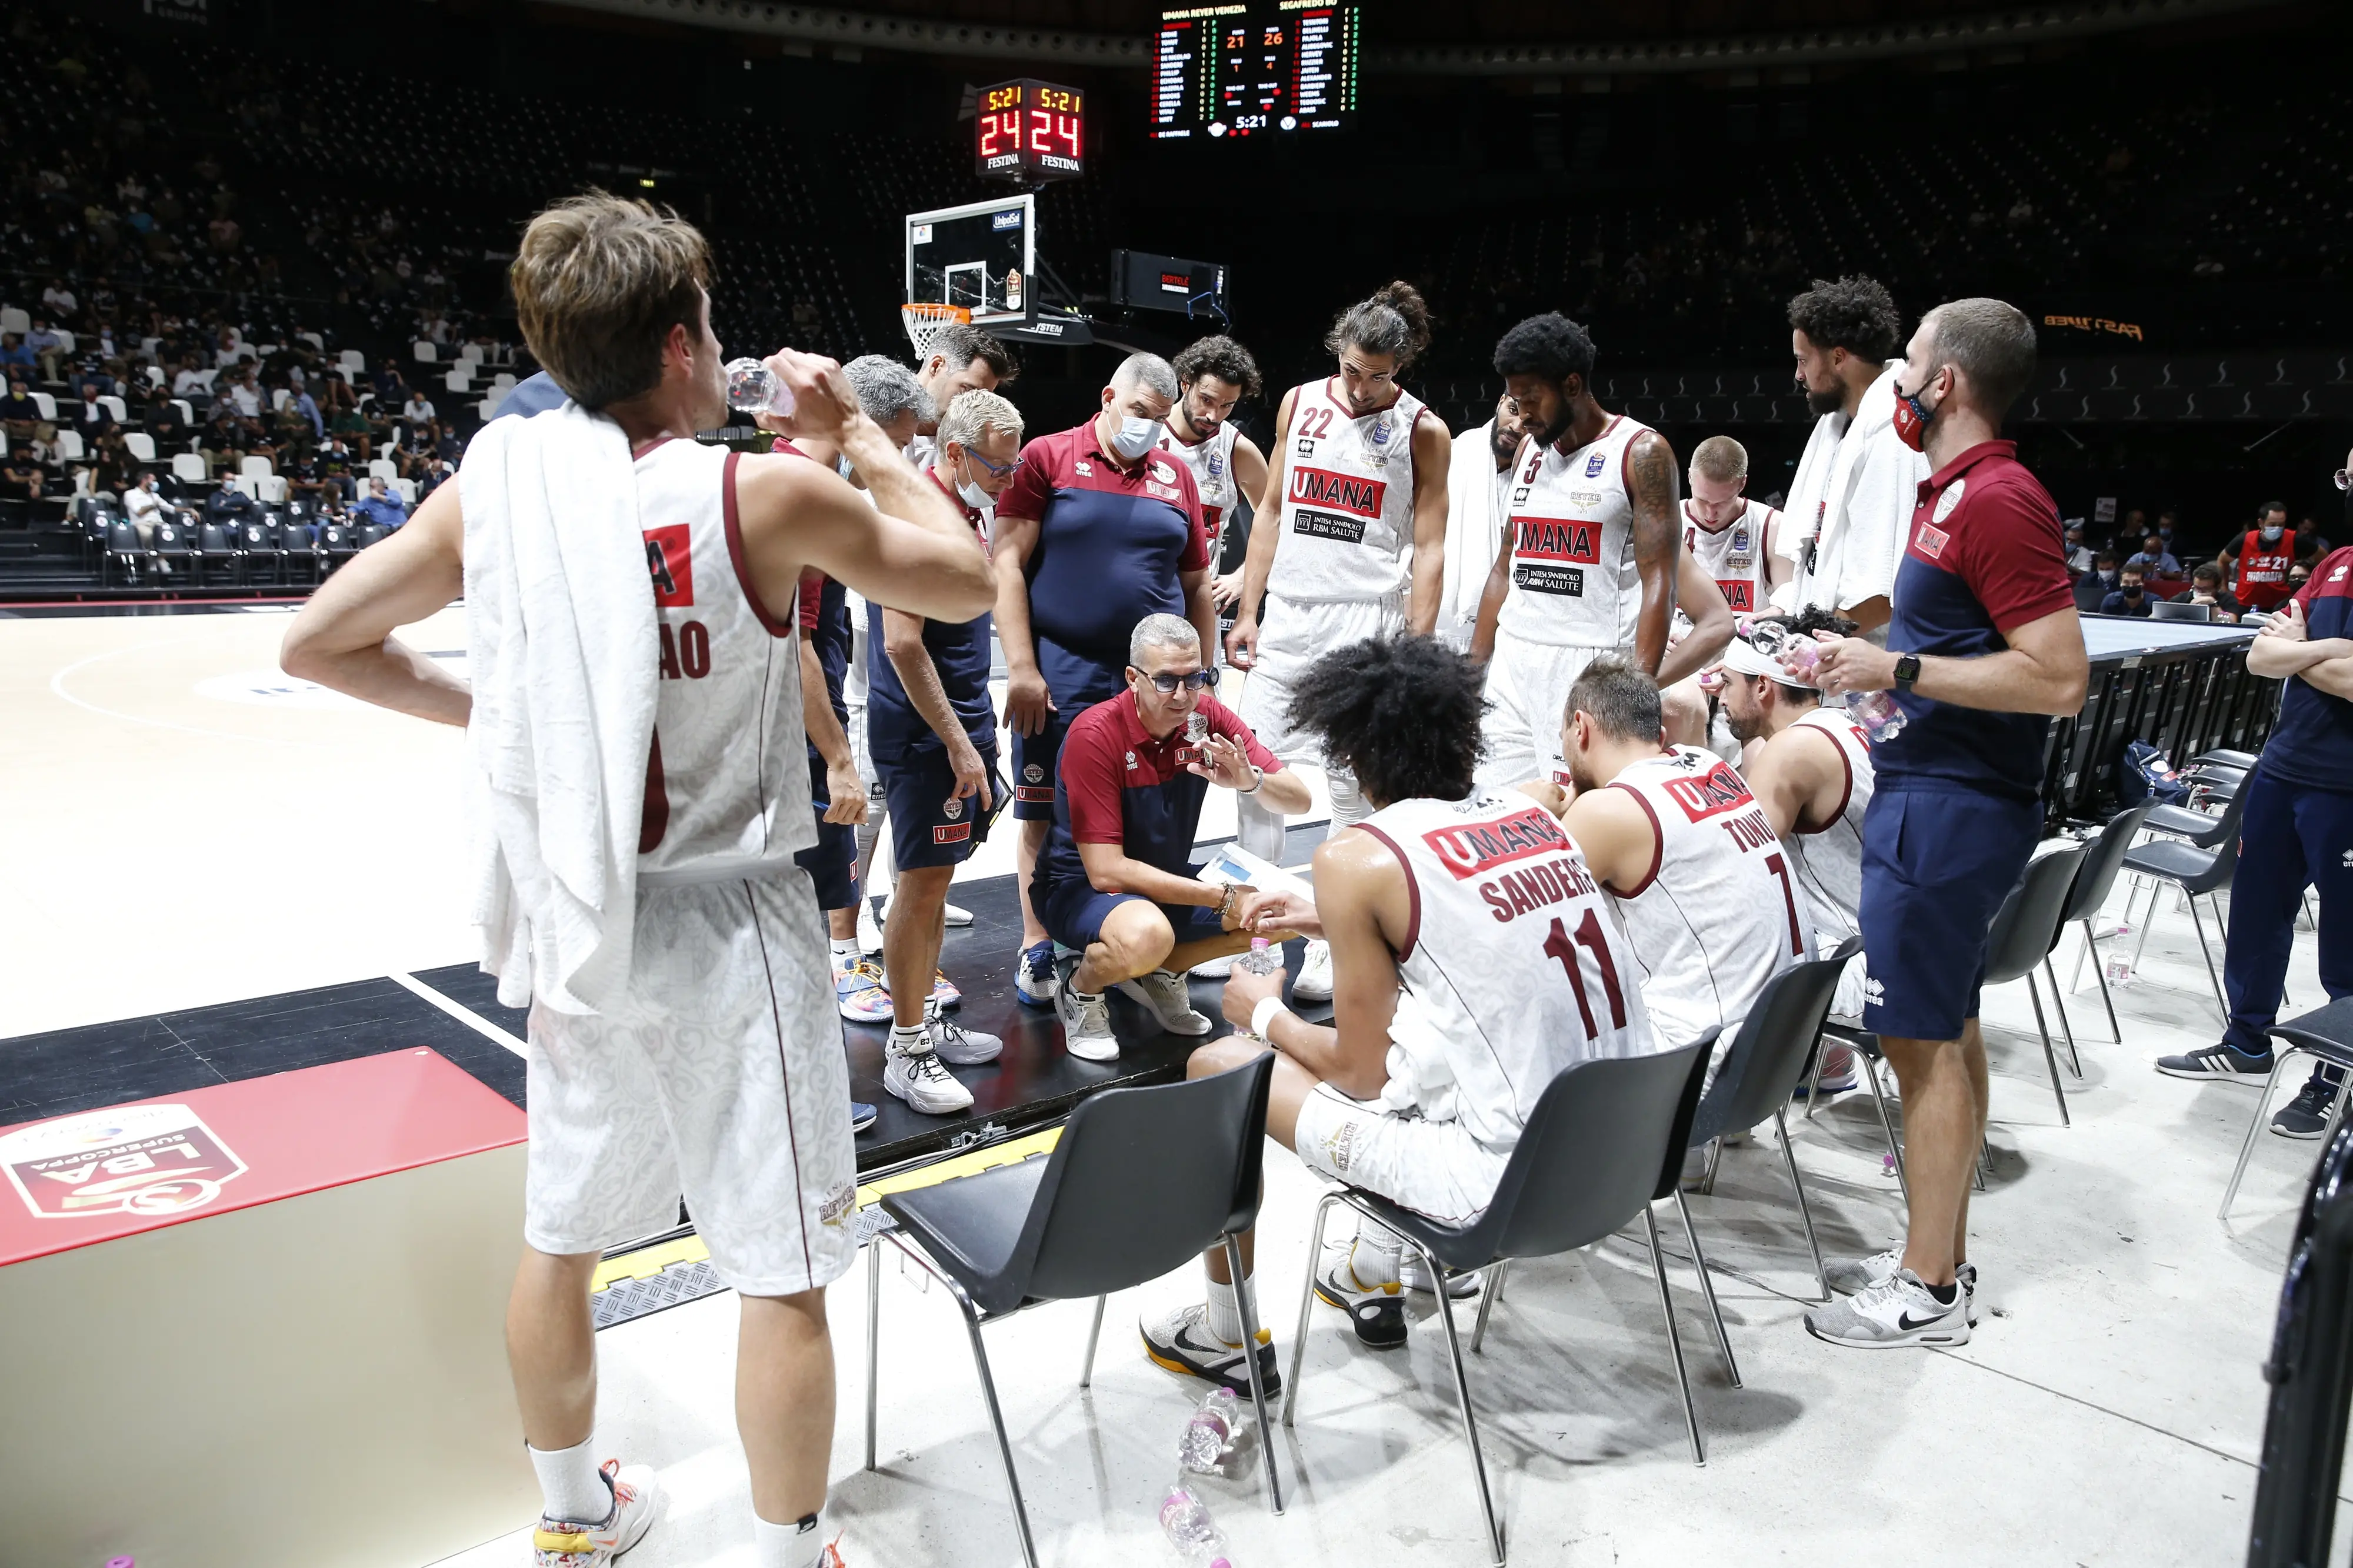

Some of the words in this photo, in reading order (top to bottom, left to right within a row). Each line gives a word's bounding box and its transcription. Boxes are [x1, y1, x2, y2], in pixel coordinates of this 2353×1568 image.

[1162, 9, 1190, 20] UMANA
[1191, 7, 1214, 18] REYER
[1215, 4, 1247, 15] VENEZIA
[1279, 0, 1324, 10] SEGAFREDO
[1227, 35, 1244, 49] 21
[1264, 32, 1283, 46] 26
[1267, 62, 1273, 70] 4
[989, 86, 1021, 111] 5:21
[1041, 88, 1080, 112] 5:21
[1236, 115, 1266, 129] 5:21
[982, 110, 1019, 156] 24
[1032, 111, 1078, 156] 24
[988, 154, 1019, 169] FESTINA
[1041, 155, 1080, 171] FESTINA
[994, 212, 1020, 227] UnipolSai
[1008, 284, 1019, 292] LBA
[1298, 407, 1334, 439] 22
[1360, 453, 1388, 465] REYER
[1075, 469, 1092, 478] errea
[1524, 452, 1542, 484] 5
[1294, 471, 1375, 513] UMANA
[1570, 492, 1601, 502] REYER
[1313, 523, 1329, 535] RBM
[1331, 526, 1359, 539] SALUTE
[1314, 516, 1331, 526] INTESA
[1332, 519, 1361, 531] SANPAOLO
[1512, 522, 1592, 558] UMANA
[2272, 556, 2288, 569] 21
[1547, 571, 1579, 581] SANPAOLO
[1527, 578, 1544, 588] RBM
[1545, 579, 1579, 591] SALUTE
[1019, 788, 1051, 799] UMANA
[937, 826, 967, 840] UMANA
[1436, 812, 1565, 868] UMANA
[1479, 858, 1597, 923] SANDERS
[1764, 852, 1804, 957] 7
[1542, 908, 1627, 1041] 11
[31, 1134, 186, 1170] SUPERCOPPA
[1338, 1122, 1358, 1171] REYER
[40, 1142, 201, 1185] LBA
[819, 1186, 855, 1220] REYER
